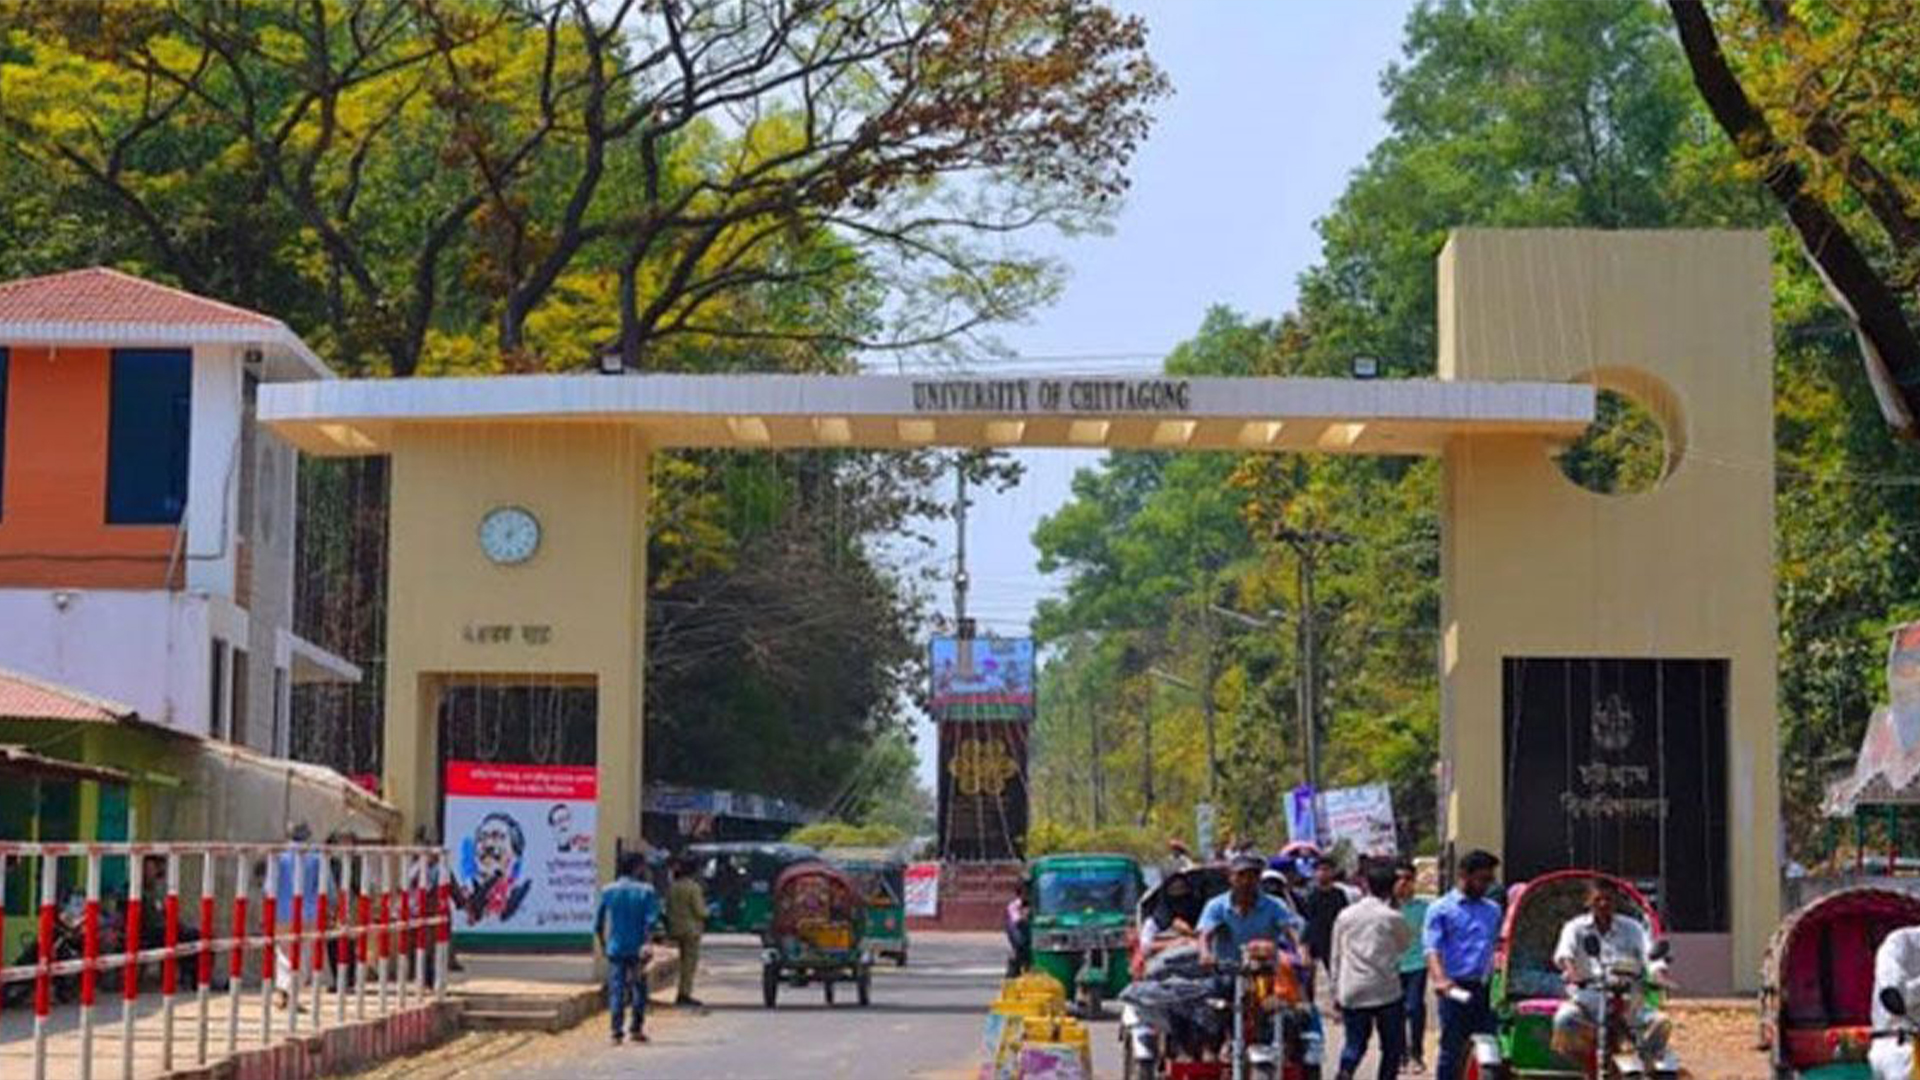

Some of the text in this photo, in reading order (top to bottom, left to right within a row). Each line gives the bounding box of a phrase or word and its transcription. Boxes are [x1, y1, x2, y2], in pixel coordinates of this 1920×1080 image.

[912, 381, 1191, 410] UNIVERSITY OF CHITTAGONG
